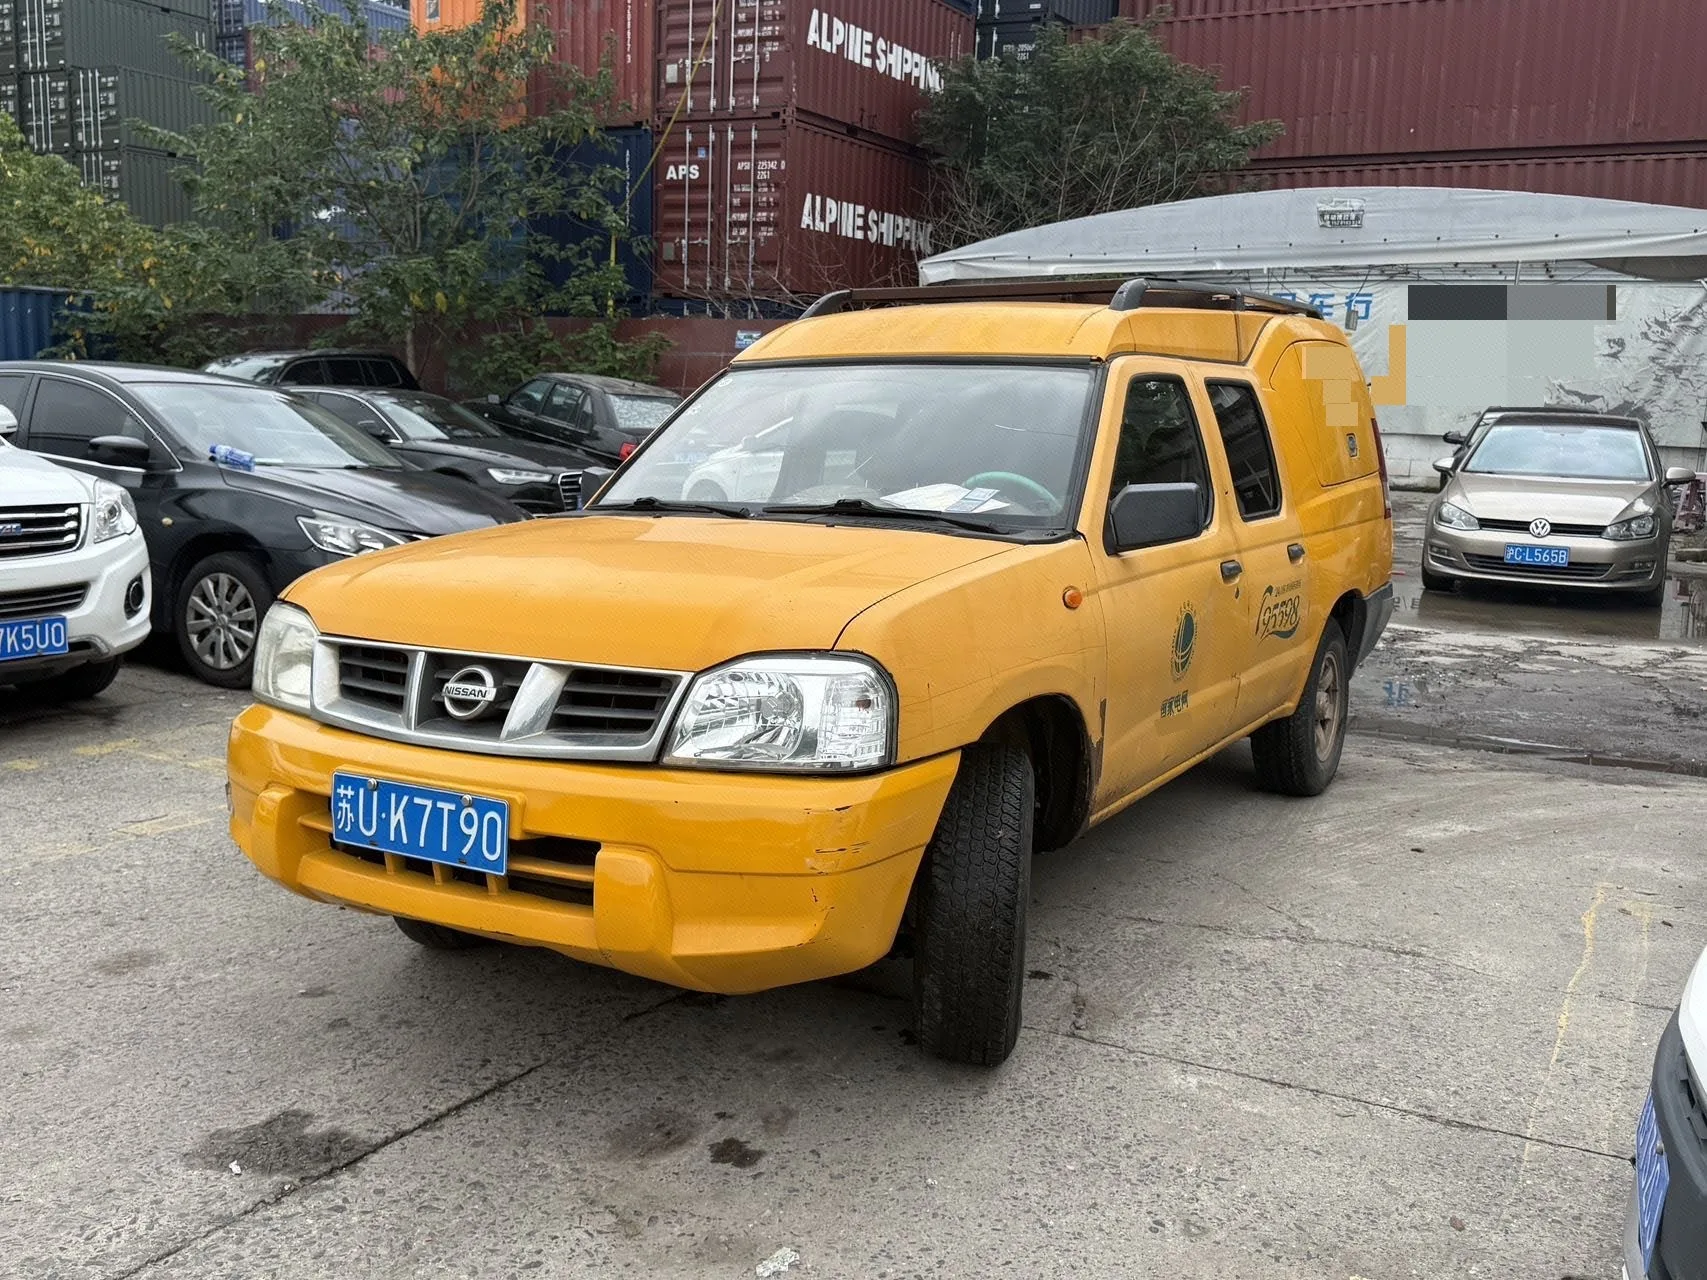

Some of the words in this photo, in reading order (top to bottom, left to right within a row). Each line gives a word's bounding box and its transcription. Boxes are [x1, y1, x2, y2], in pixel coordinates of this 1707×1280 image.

[807, 9, 871, 68] ALPINE
[666, 164, 700, 180] APS
[801, 193, 865, 240] ALPINE
[444, 686, 488, 698] NISSAN
